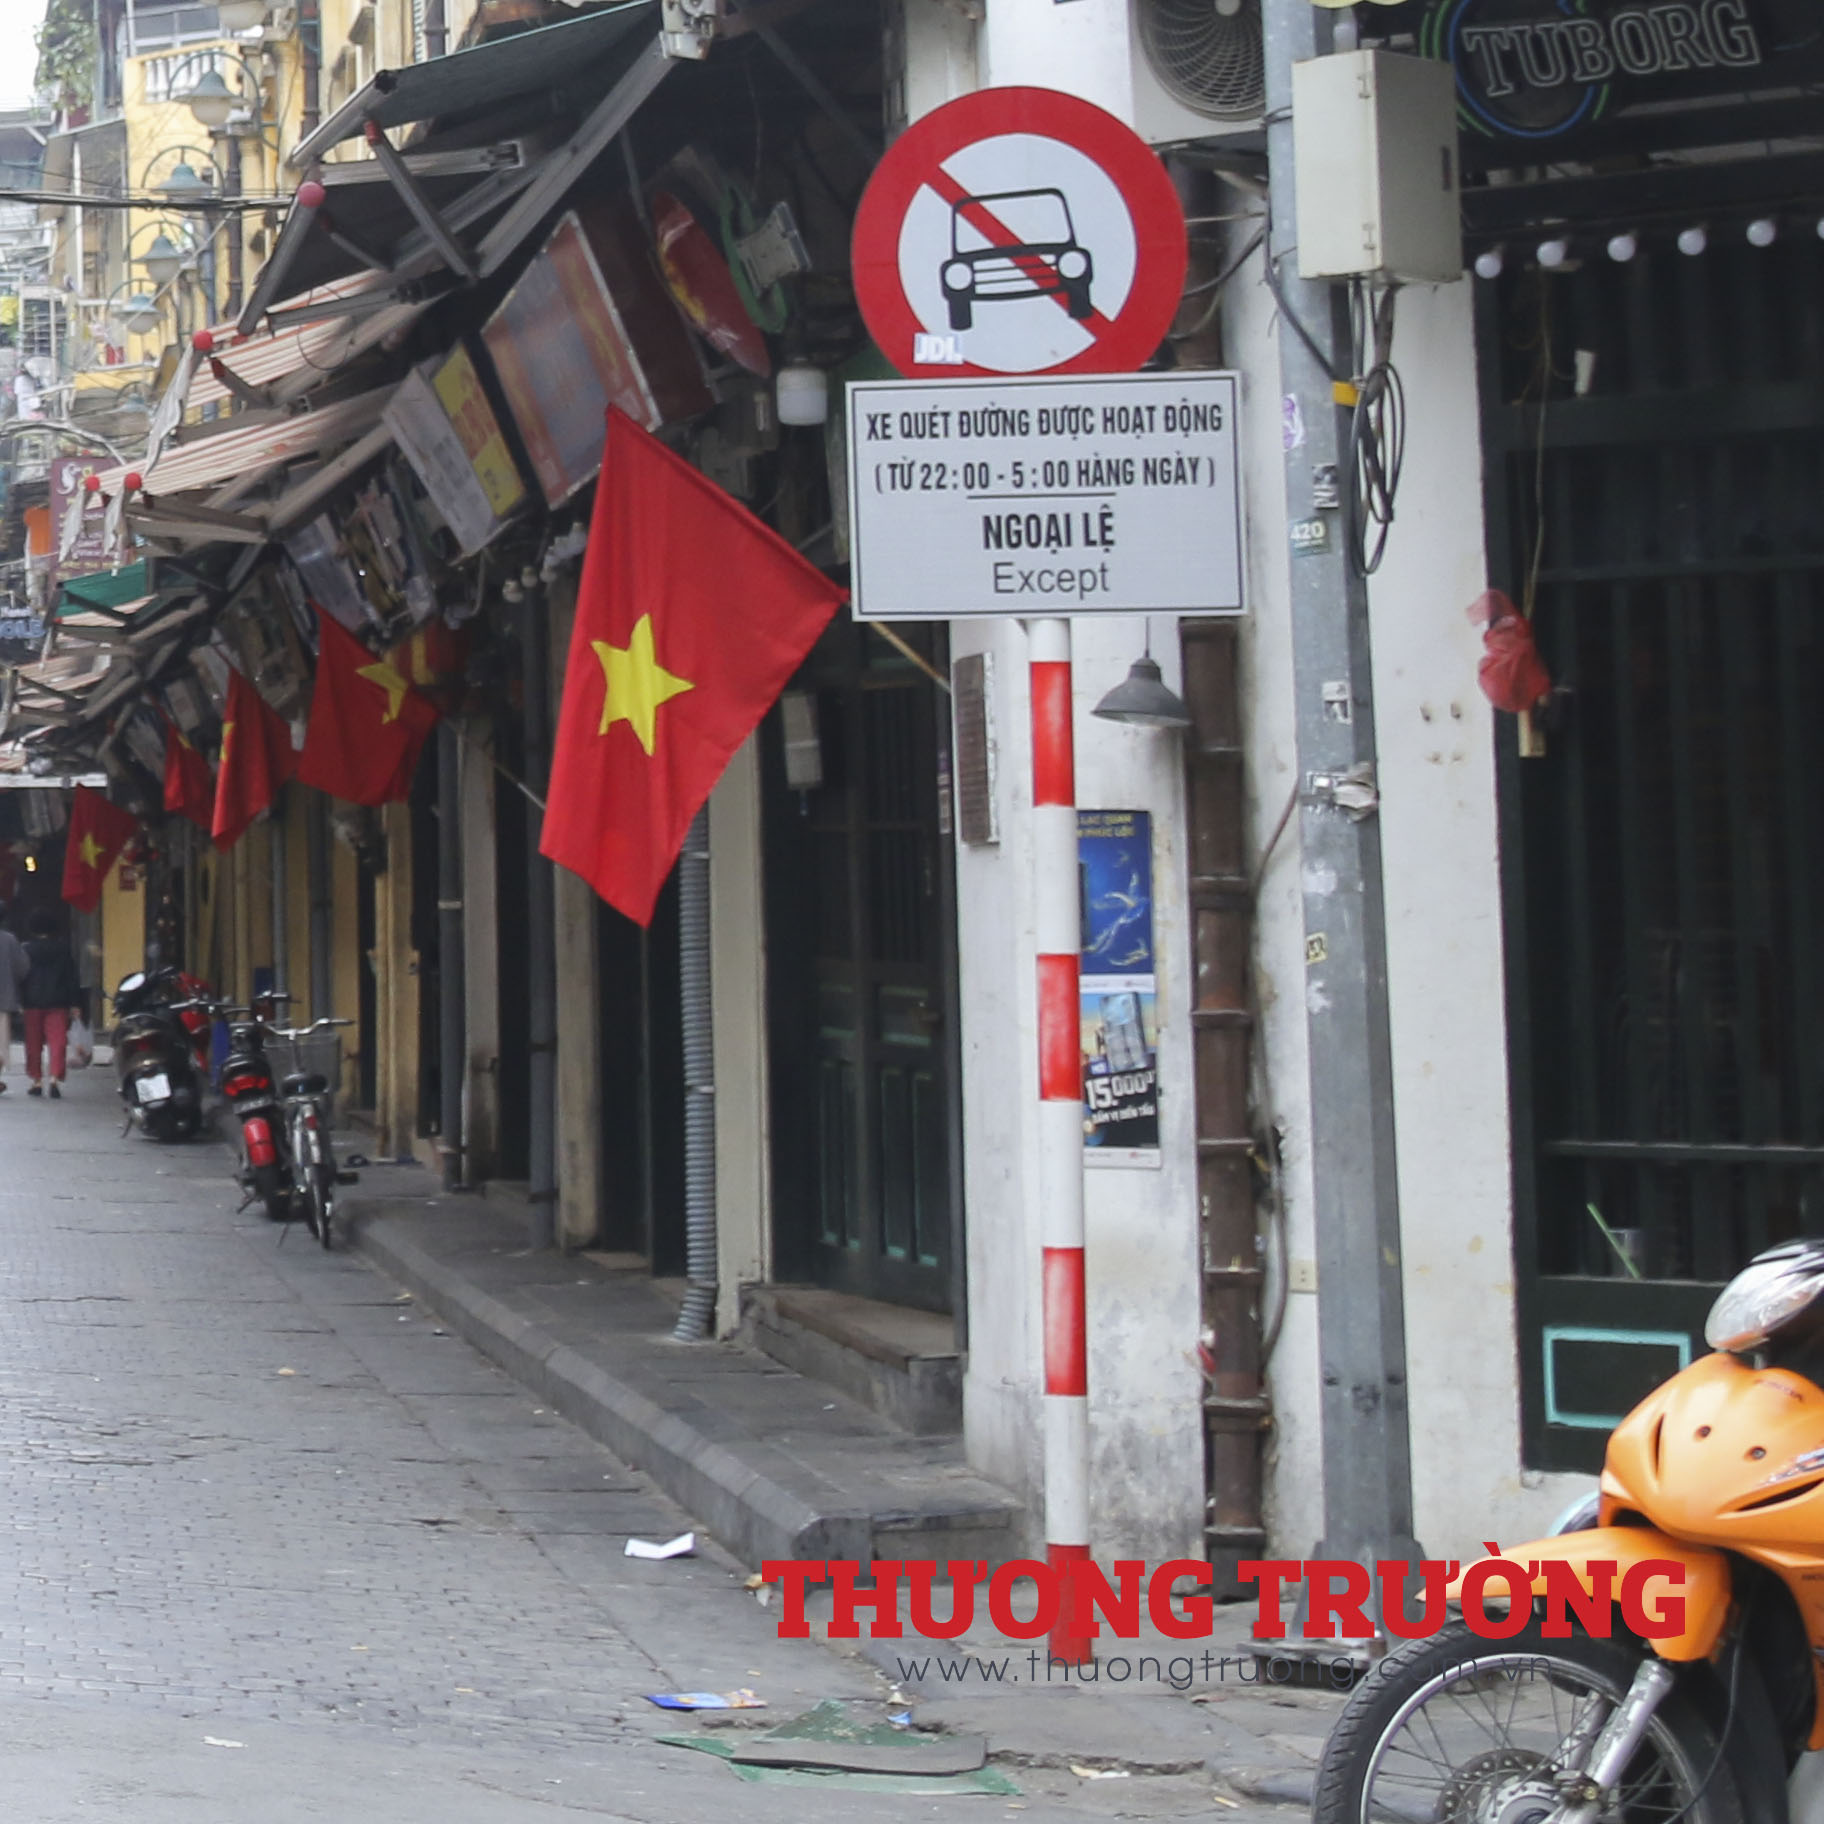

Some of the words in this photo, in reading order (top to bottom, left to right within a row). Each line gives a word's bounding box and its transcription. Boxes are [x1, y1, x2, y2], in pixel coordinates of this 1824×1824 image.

[867, 411, 891, 440] XE
[899, 403, 950, 440] QUÉT
[958, 401, 1030, 437] ĐƯỜNG
[1038, 404, 1094, 442] ĐƯỢC
[1103, 404, 1156, 440] HOẠT
[1164, 397, 1222, 438] ĐỘNG
[1077, 453, 1135, 487] HÀNG
[983, 512, 1073, 554] NGOẠI
[1083, 504, 1116, 553] LỆ
[1290, 522, 1324, 540] 420
[993, 561, 1110, 599] Except
